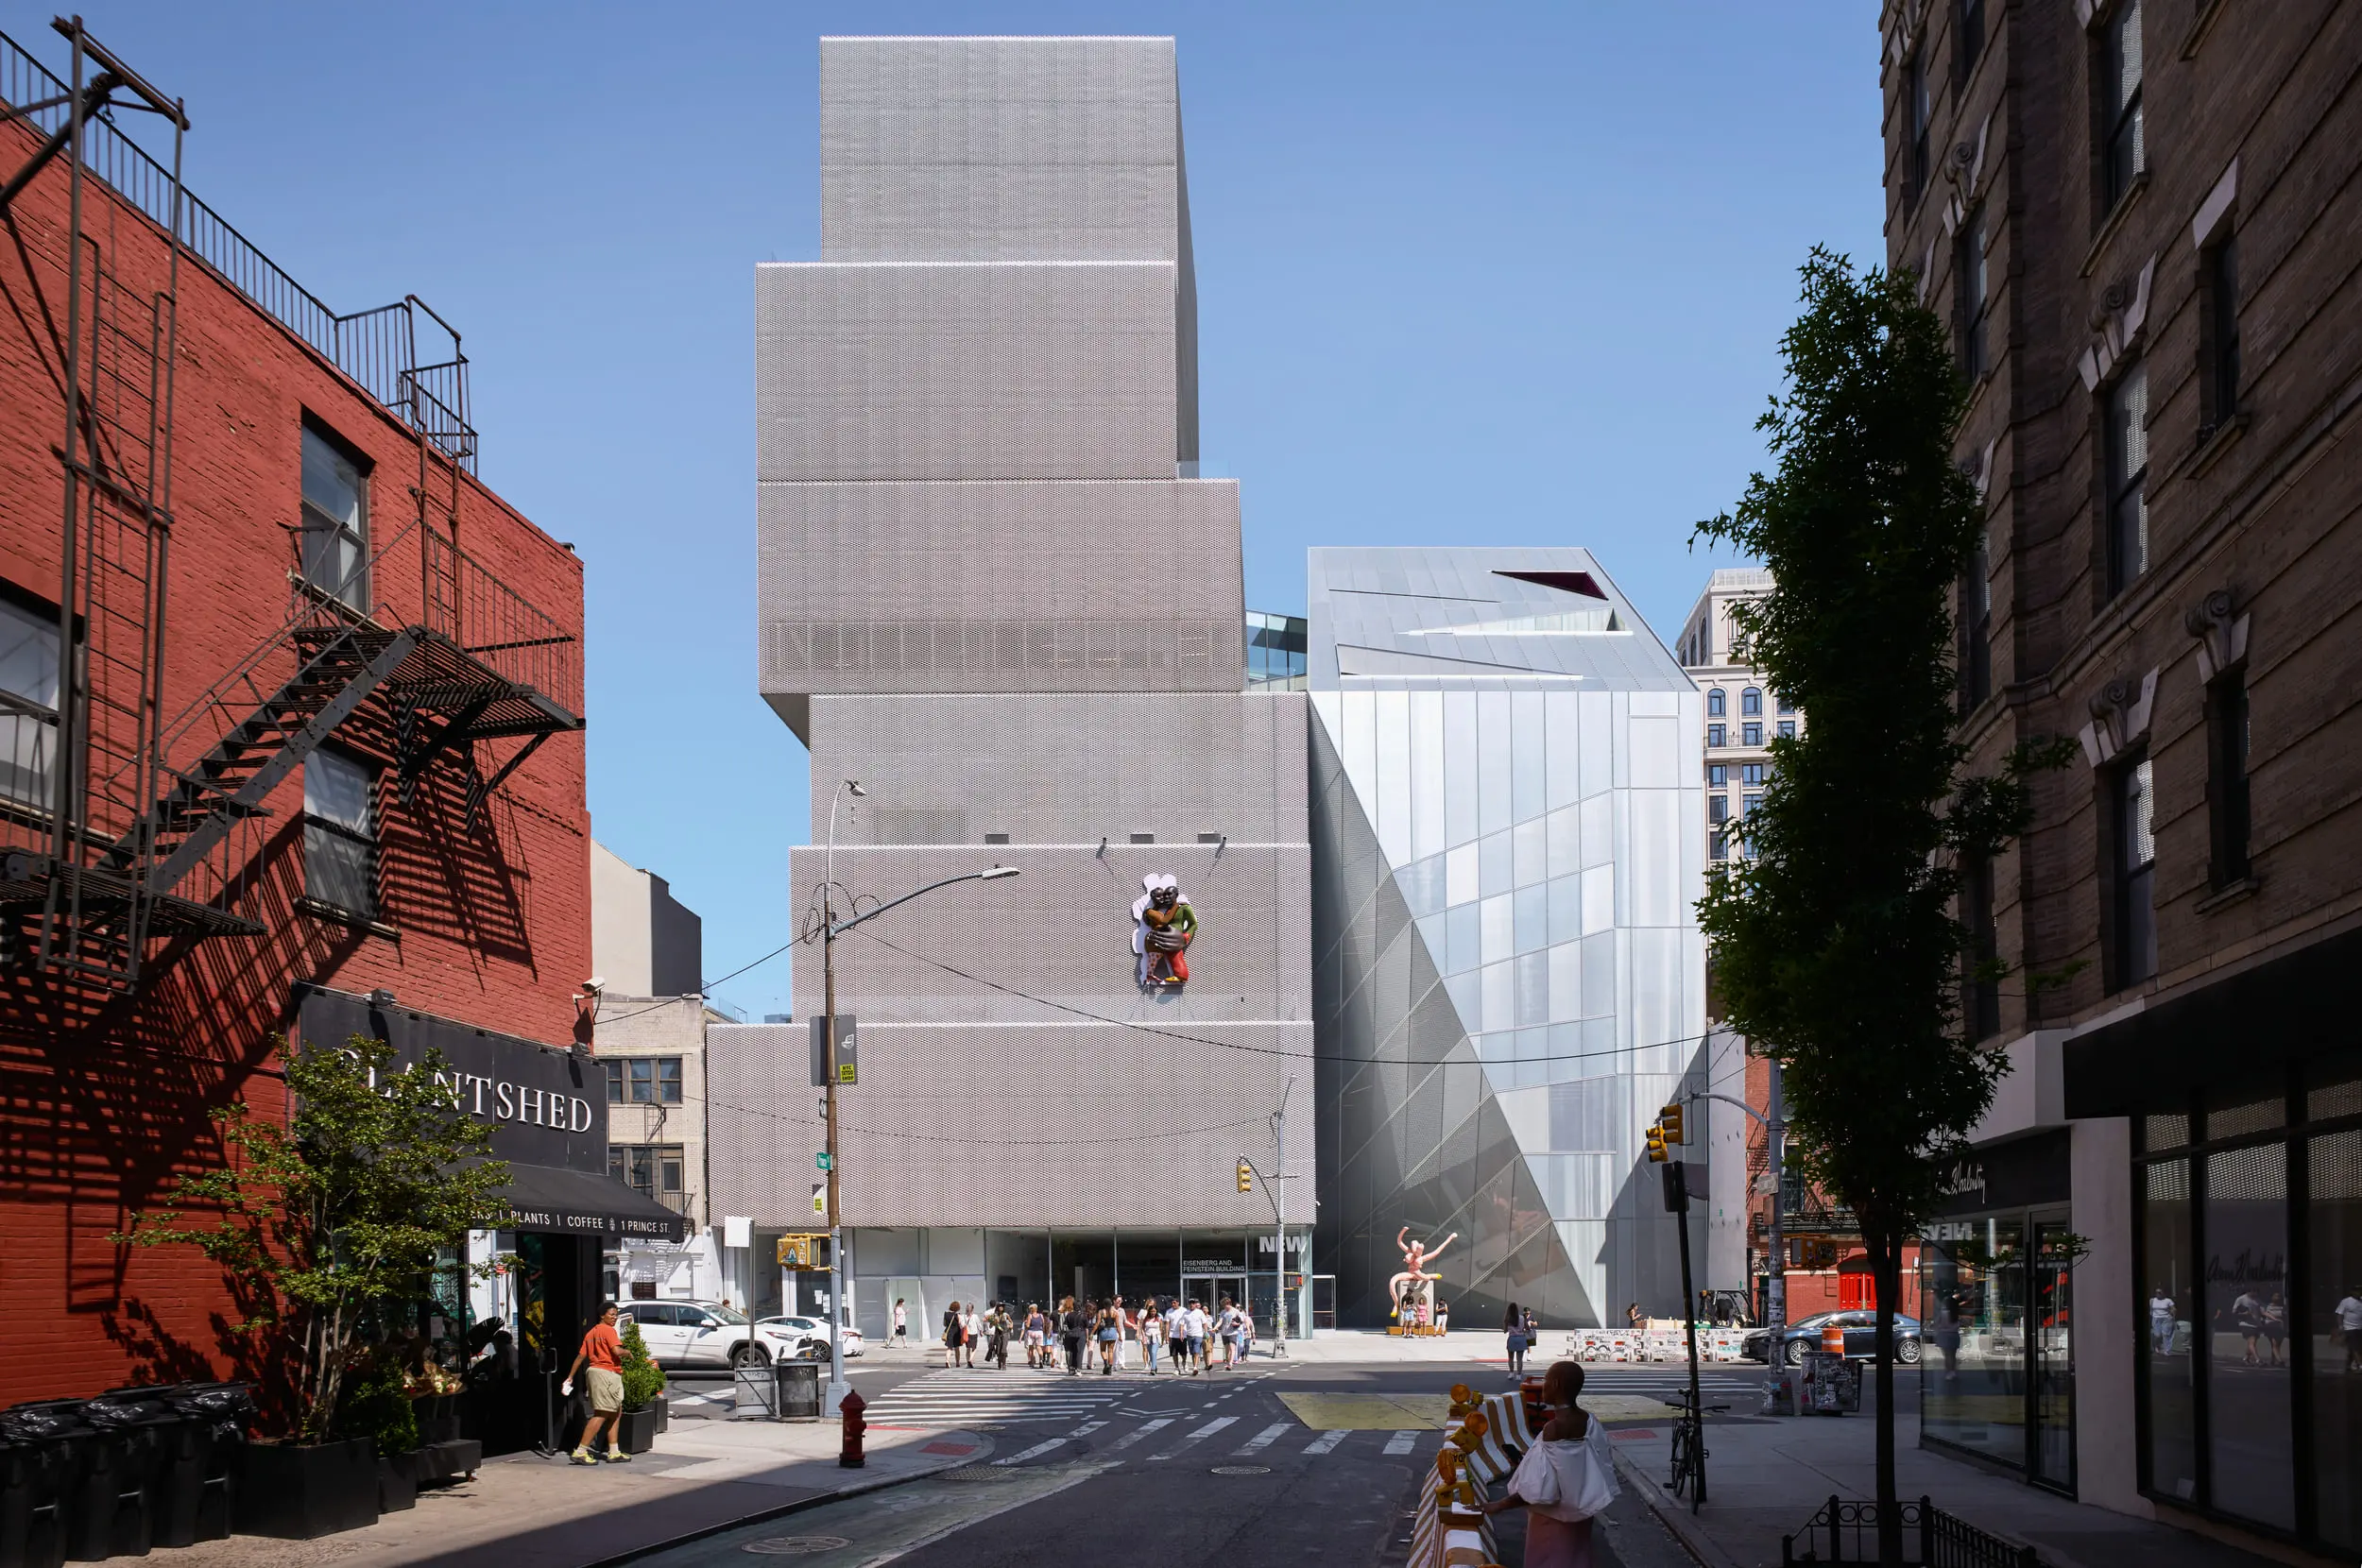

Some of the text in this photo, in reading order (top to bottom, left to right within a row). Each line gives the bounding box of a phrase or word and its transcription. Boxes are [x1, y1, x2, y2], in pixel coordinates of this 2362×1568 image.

[511, 1211, 671, 1234] PLANTS COFFEE 1 PRINCE ST.
